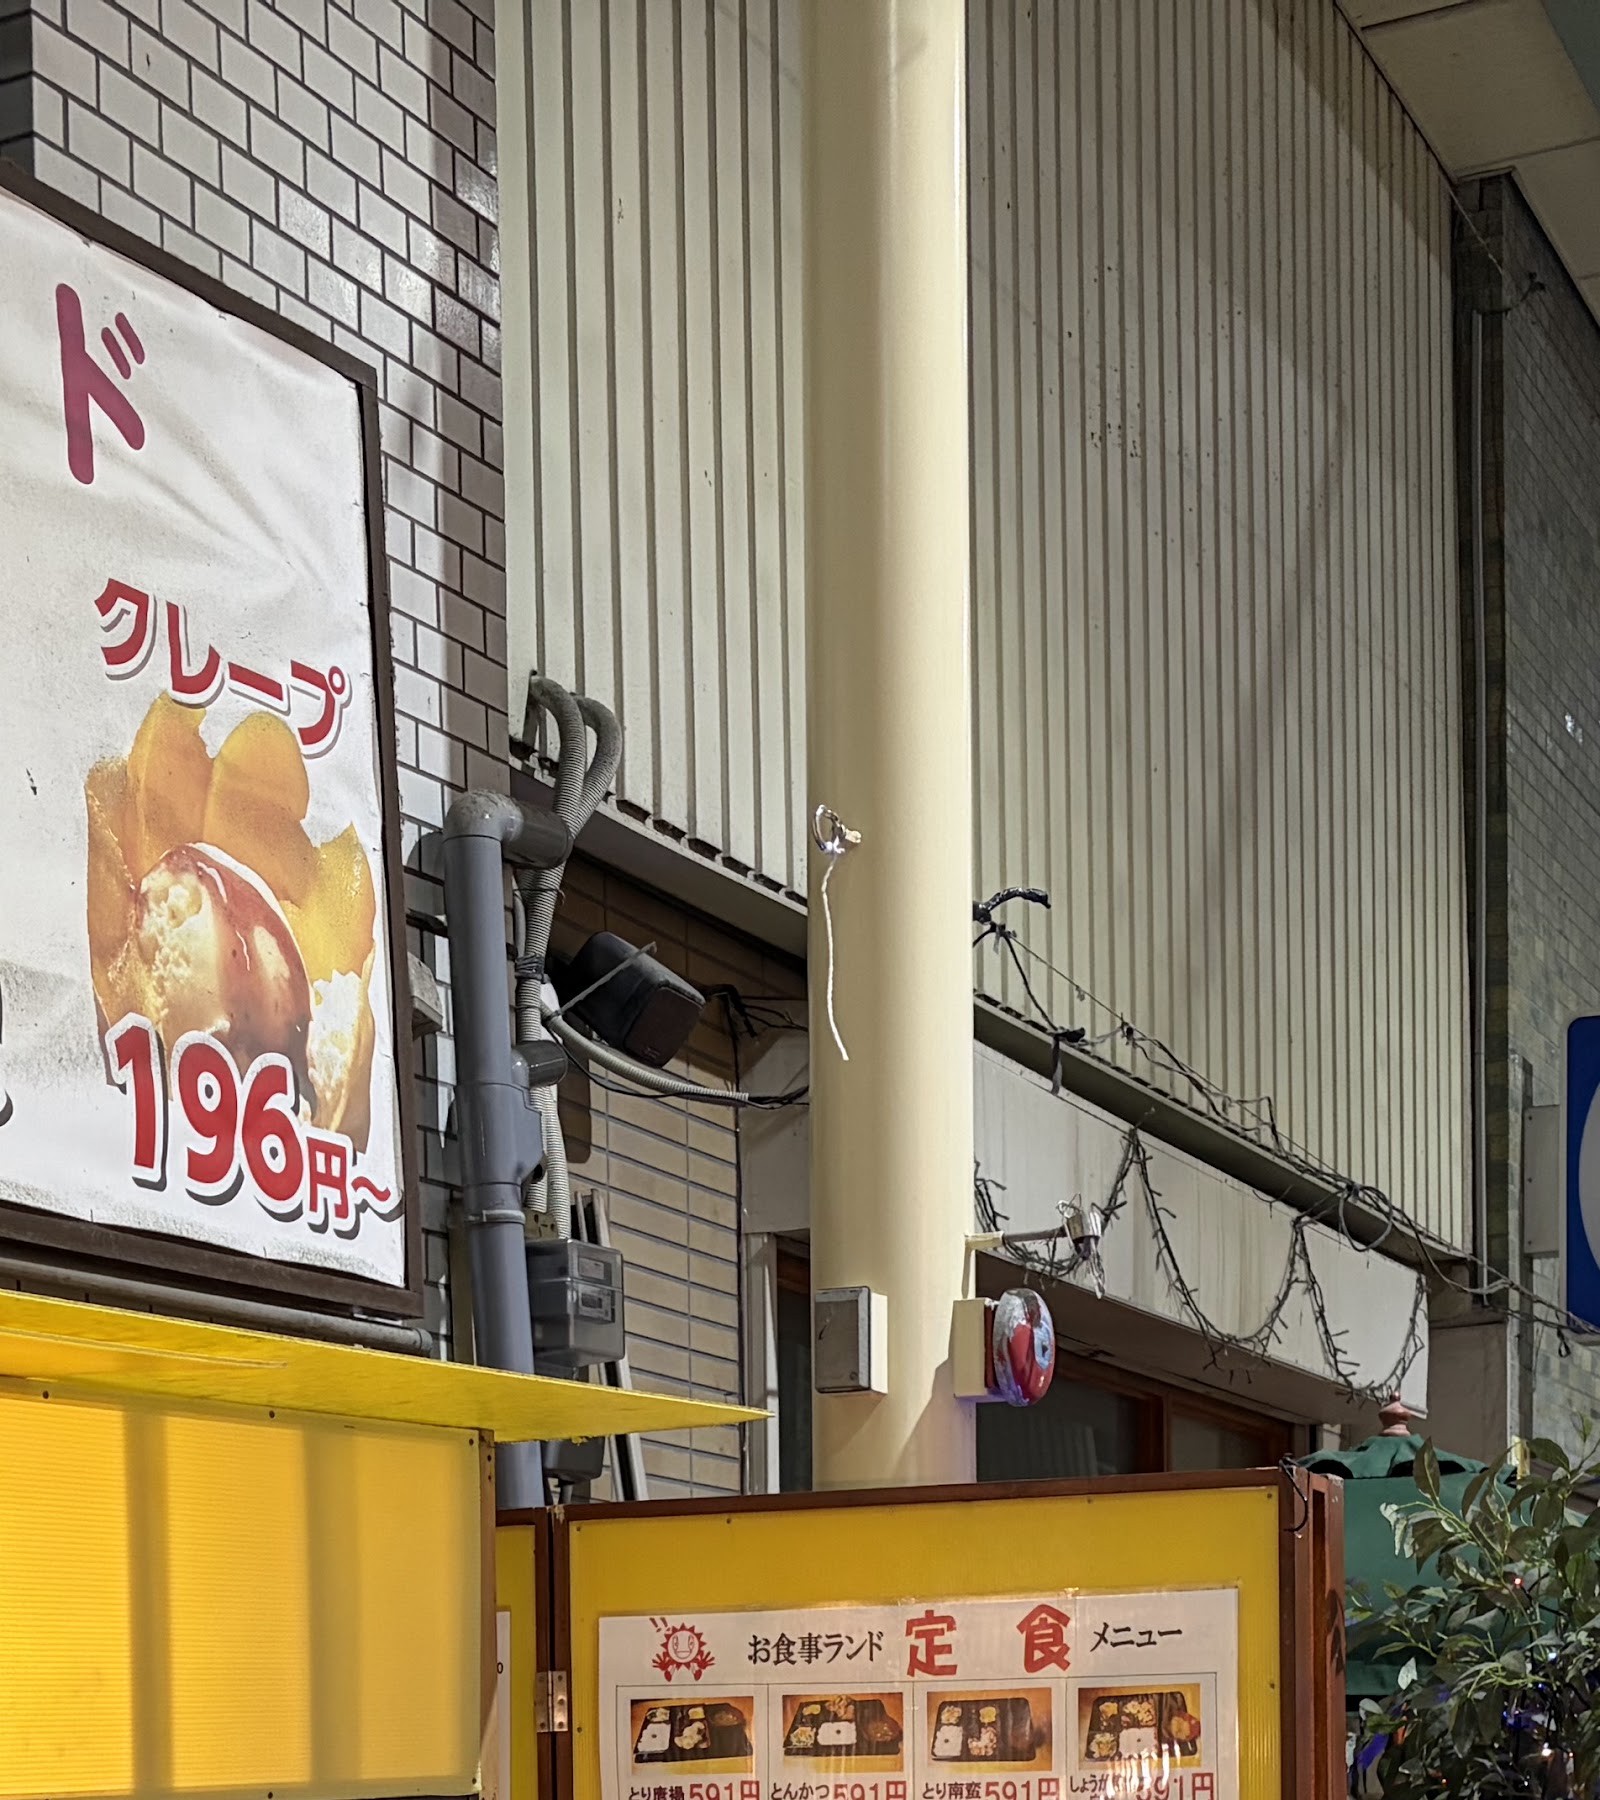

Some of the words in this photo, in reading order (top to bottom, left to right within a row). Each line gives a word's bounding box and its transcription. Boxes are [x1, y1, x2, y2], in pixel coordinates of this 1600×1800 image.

[94, 582, 350, 750] クレープ
[116, 1029, 395, 1223] 196円～
[748, 1630, 885, 1665] お食事ランド
[1091, 1624, 1183, 1652] メニュー
[771, 1782, 830, 1800] とんかつ
[922, 1782, 982, 1800] とり南蛮
